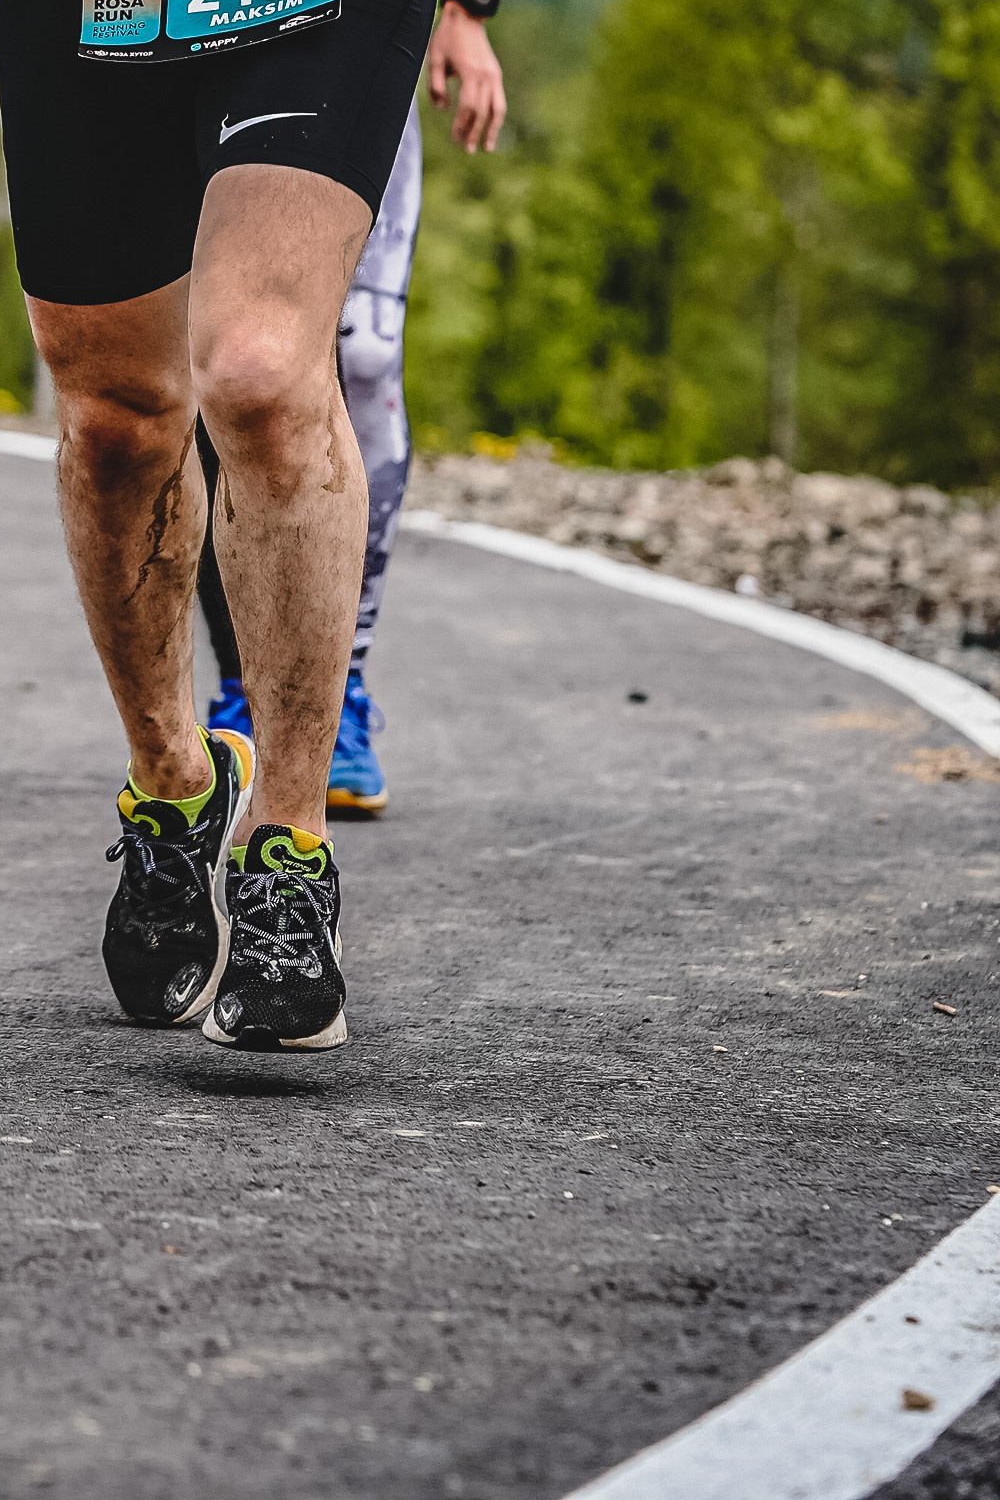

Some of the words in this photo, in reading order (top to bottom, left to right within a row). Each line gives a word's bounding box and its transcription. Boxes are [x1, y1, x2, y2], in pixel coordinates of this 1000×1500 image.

[93, 9, 133, 23] RUN
[93, 21, 146, 33] RUNNING
[92, 29, 140, 39] FESTIVAL
[203, 36, 239, 49] YAPPY
